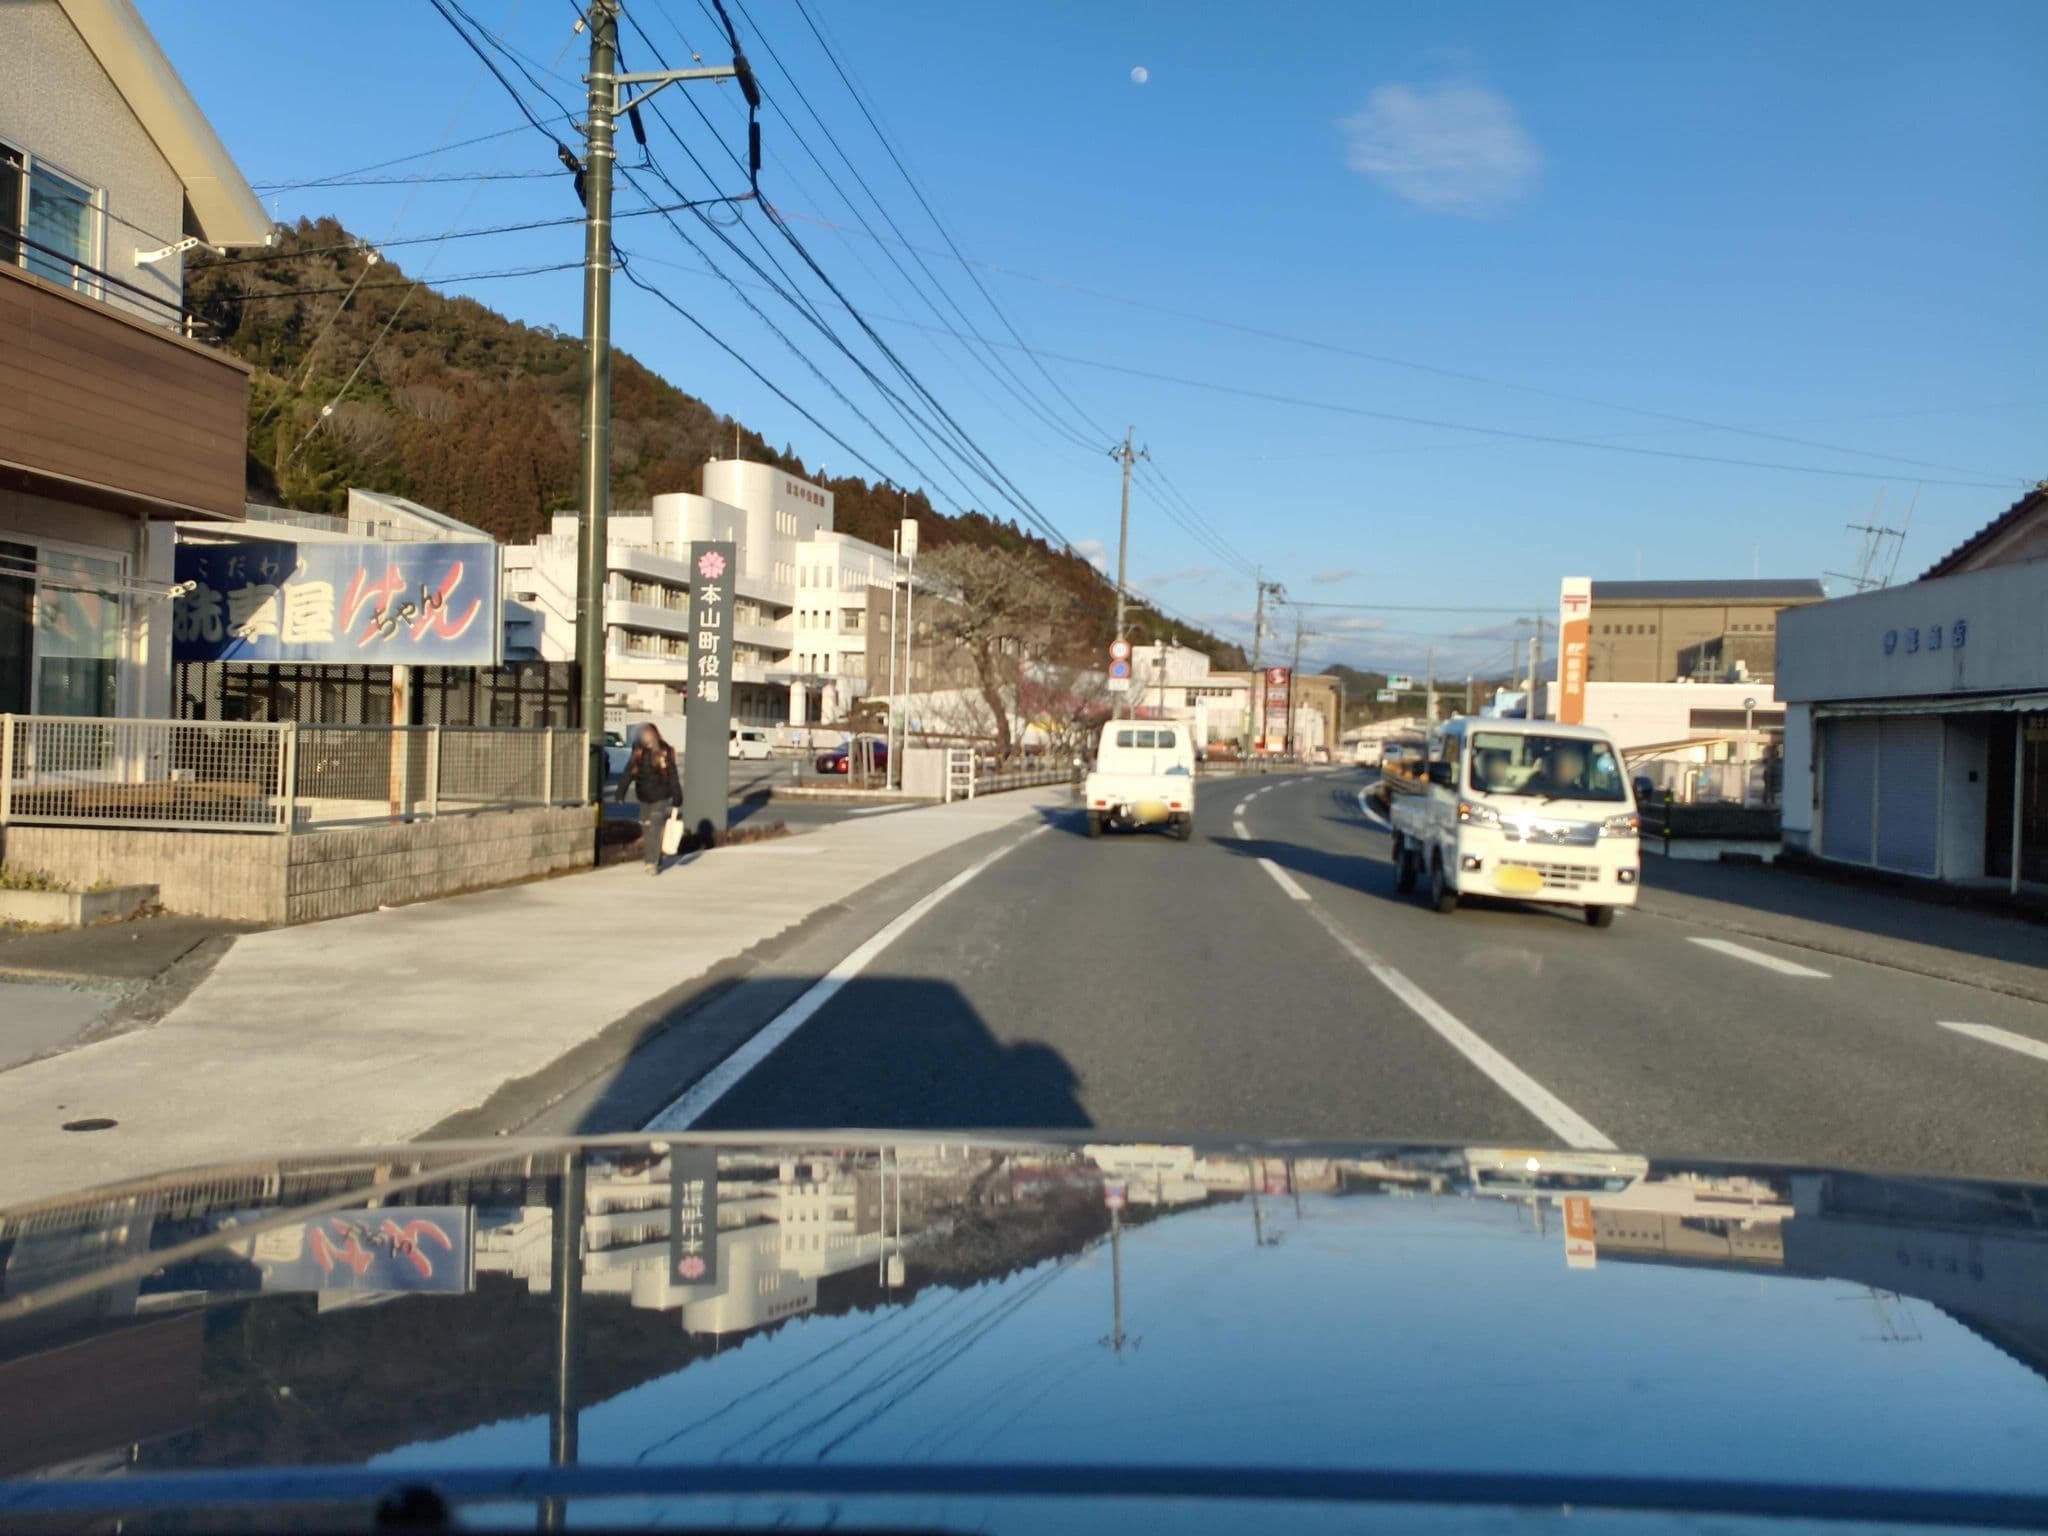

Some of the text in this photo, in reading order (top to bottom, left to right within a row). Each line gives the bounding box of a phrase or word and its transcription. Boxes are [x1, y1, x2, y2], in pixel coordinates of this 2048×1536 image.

[697, 583, 722, 703] 本山町役場
